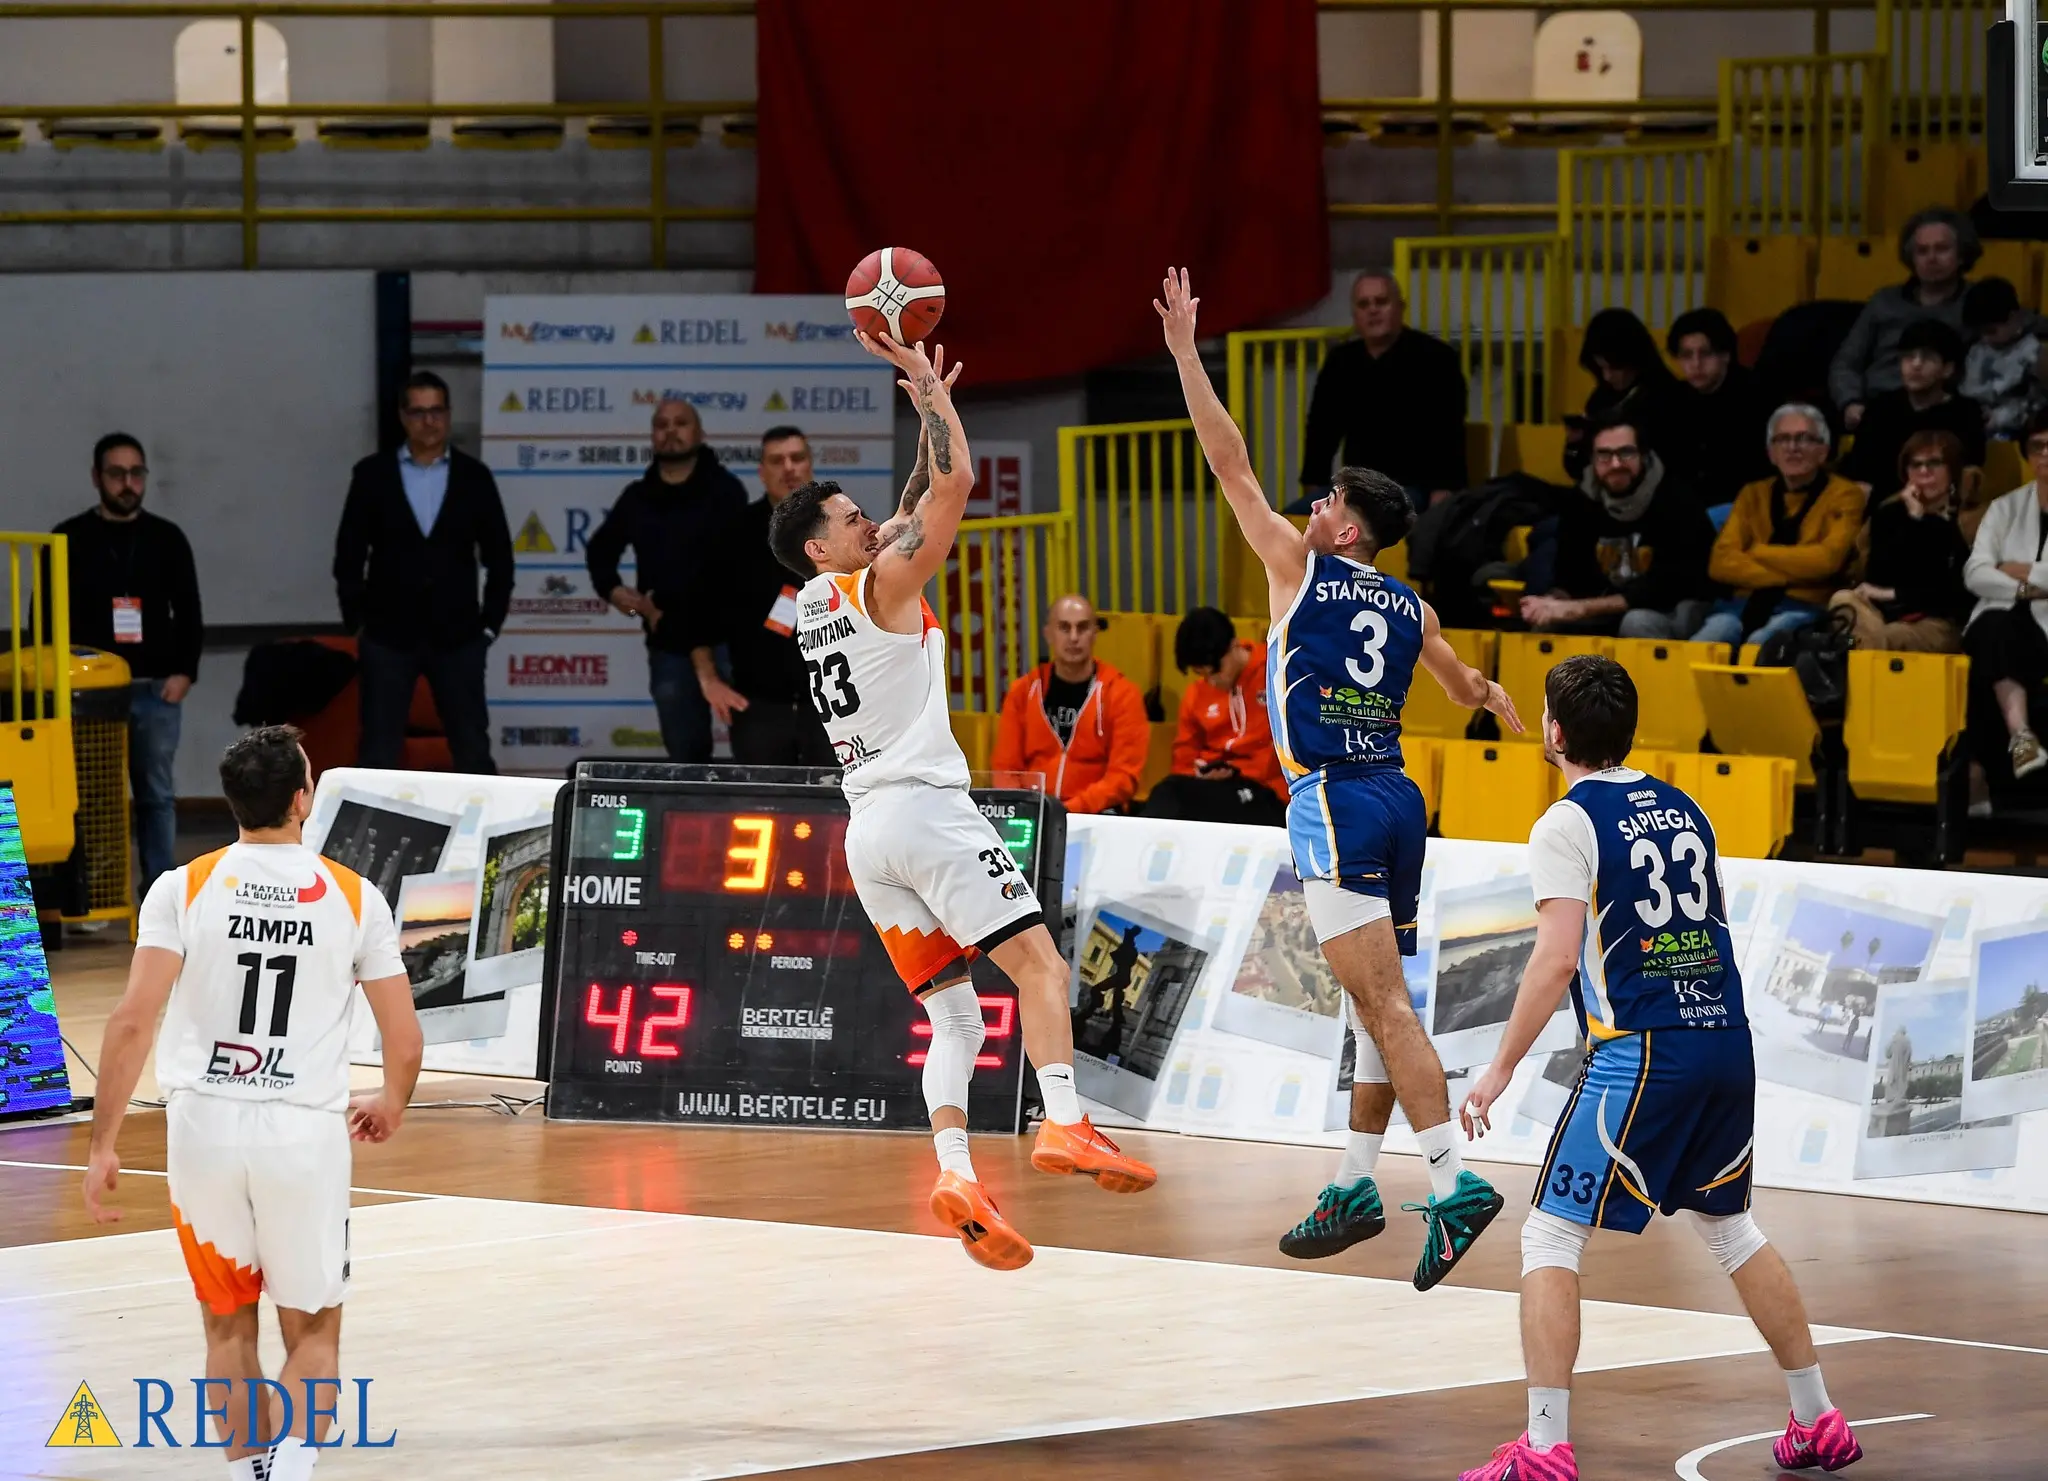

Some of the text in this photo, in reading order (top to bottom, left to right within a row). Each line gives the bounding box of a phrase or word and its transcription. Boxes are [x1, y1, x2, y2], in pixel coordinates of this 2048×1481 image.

[660, 319, 748, 344] REDEL
[764, 321, 855, 344] MyEner
[527, 387, 614, 413] REDEL
[791, 387, 879, 413] REDEL
[578, 446, 624, 466] SERIE
[1344, 609, 1388, 689] 3
[507, 654, 609, 675] LEONTE
[805, 650, 862, 724] 33
[591, 794, 627, 809] FOULS
[979, 804, 1016, 819] FOULS
[612, 807, 646, 860] 3
[1617, 808, 1699, 842] SAPIEGA
[978, 847, 1016, 879] 33
[244, 882, 298, 895] FRATELLI
[564, 875, 642, 905] HOME
[1630, 831, 1709, 929] 33
[235, 889, 296, 903] LA BUFALA
[227, 914, 314, 946] ZAMPA
[1680, 929, 1712, 951] SEA
[635, 951, 676, 967] TIME-OUT
[770, 956, 813, 971] PERIODS
[236, 951, 298, 1038] 11
[585, 983, 692, 1057] 42
[1680, 1004, 1728, 1020] BRINDISI
[742, 1026, 833, 1040] ELECTRONICS
[206, 1040, 295, 1079] EDIL
[604, 1059, 642, 1075] POINTS
[678, 1091, 886, 1122] WWW.BERTELE.EU
[1551, 1163, 1597, 1205] 33
